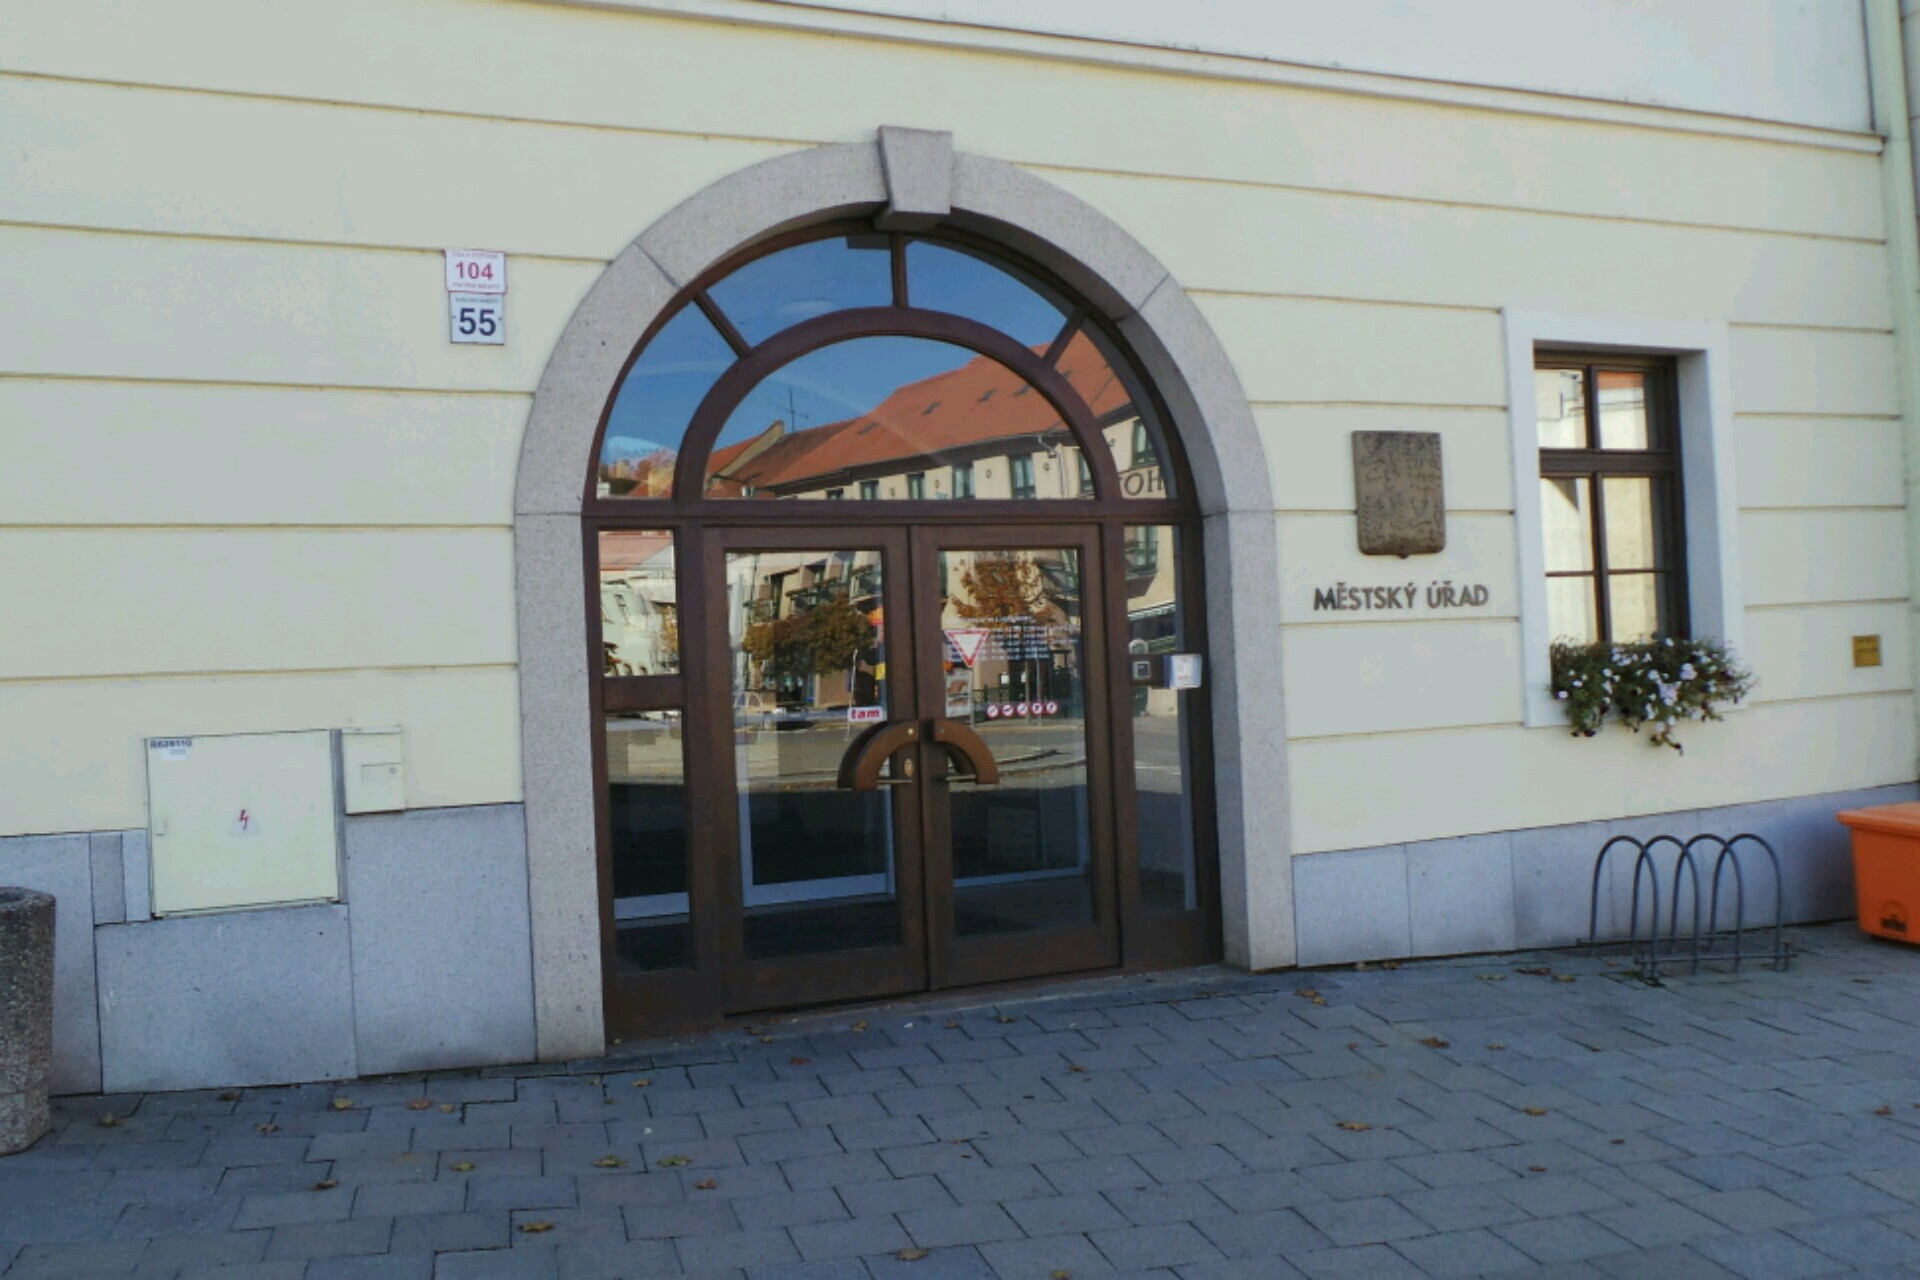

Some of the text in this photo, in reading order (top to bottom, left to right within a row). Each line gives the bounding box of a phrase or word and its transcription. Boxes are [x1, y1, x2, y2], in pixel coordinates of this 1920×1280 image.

[456, 262, 493, 280] 104
[459, 307, 496, 336] 55
[1313, 580, 1489, 611] MĚSTSKÝ ÚŘAD
[851, 708, 880, 719] tam
